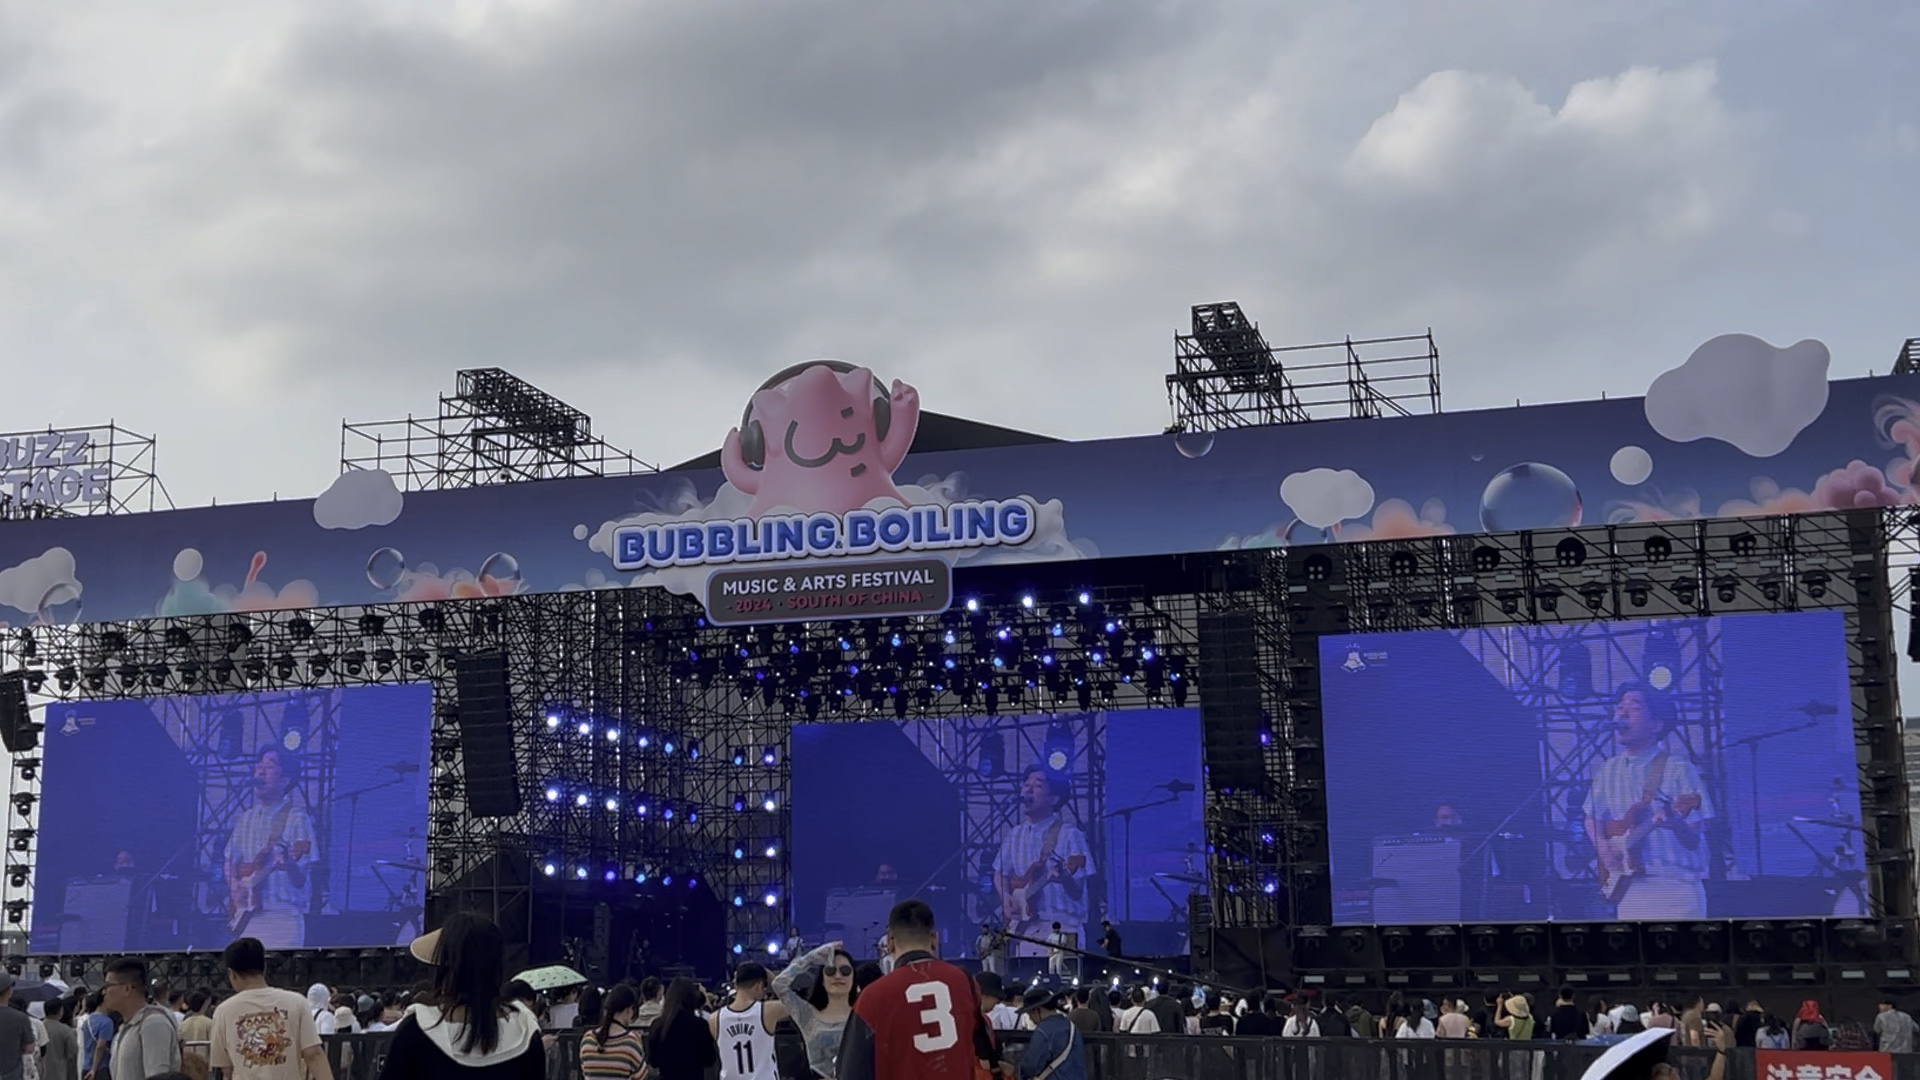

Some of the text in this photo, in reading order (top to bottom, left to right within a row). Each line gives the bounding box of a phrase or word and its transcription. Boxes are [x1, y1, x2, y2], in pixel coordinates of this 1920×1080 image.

[0, 468, 108, 507] TAGE
[618, 523, 837, 563] BUBBLING
[848, 504, 1030, 546] BOILING
[722, 568, 935, 596] MUSIC & ARTS FESTIVAL
[734, 589, 923, 613] 2024 SOUTH OF CHINA
[726, 1023, 756, 1038] IRVING
[905, 980, 959, 1053] 3
[733, 1040, 755, 1075] 11
